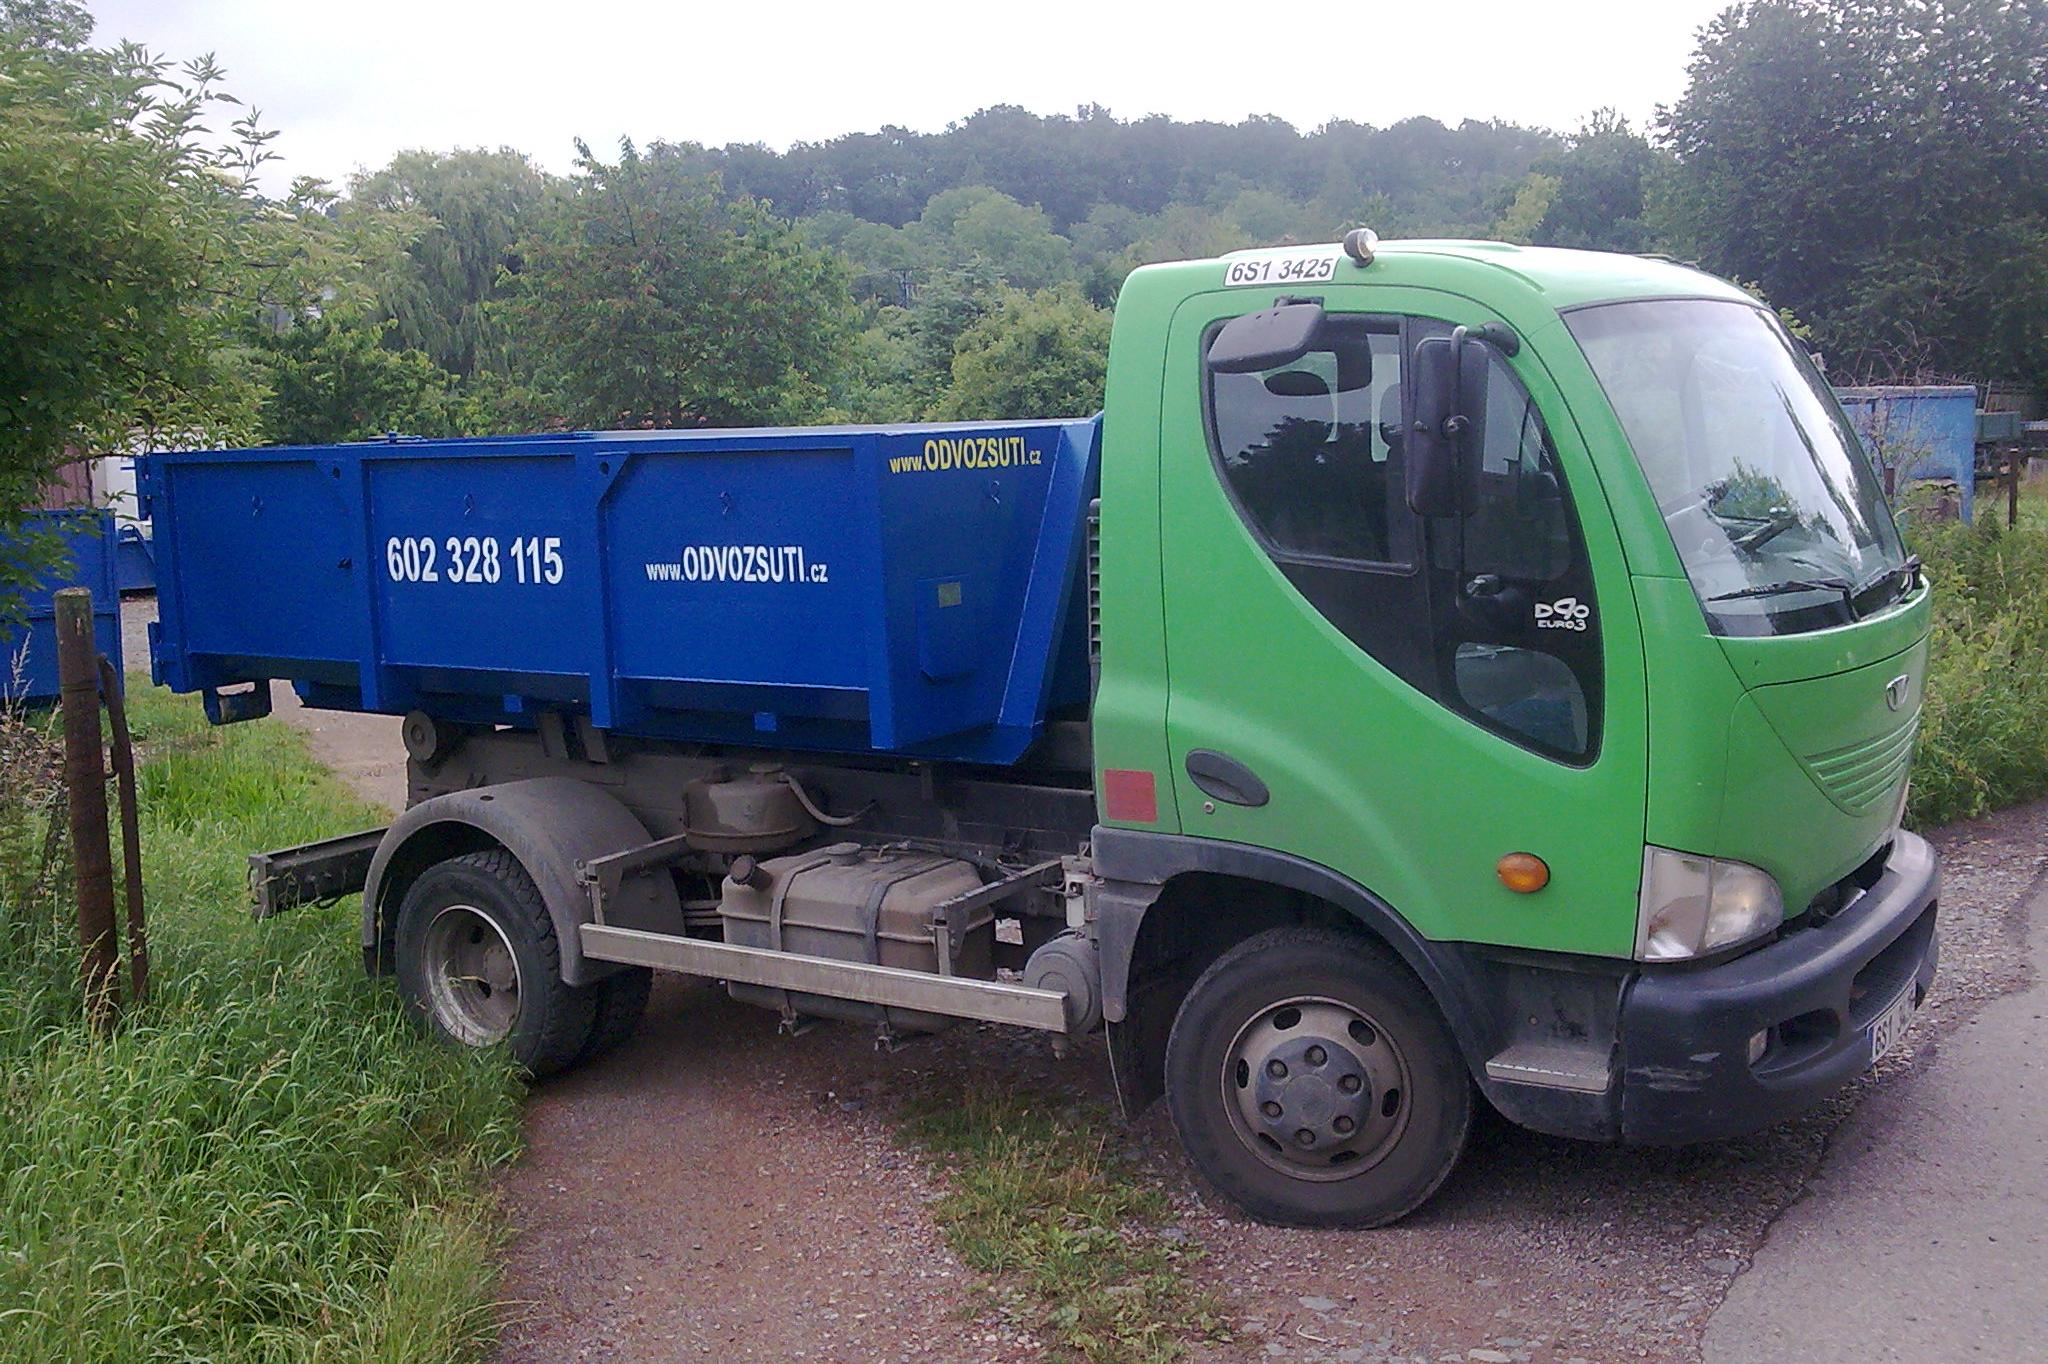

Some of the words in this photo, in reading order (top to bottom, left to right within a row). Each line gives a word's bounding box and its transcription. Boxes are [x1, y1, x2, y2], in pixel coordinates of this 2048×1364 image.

[1232, 260, 1272, 282] 6S1
[1278, 258, 1334, 280] 3425
[889, 437, 1042, 474] www.ODVOZSUTI.cz
[387, 537, 438, 582] 602
[446, 537, 500, 583] 328
[510, 537, 563, 584] 115
[646, 546, 829, 583] www.ODVOZSUTI.cz
